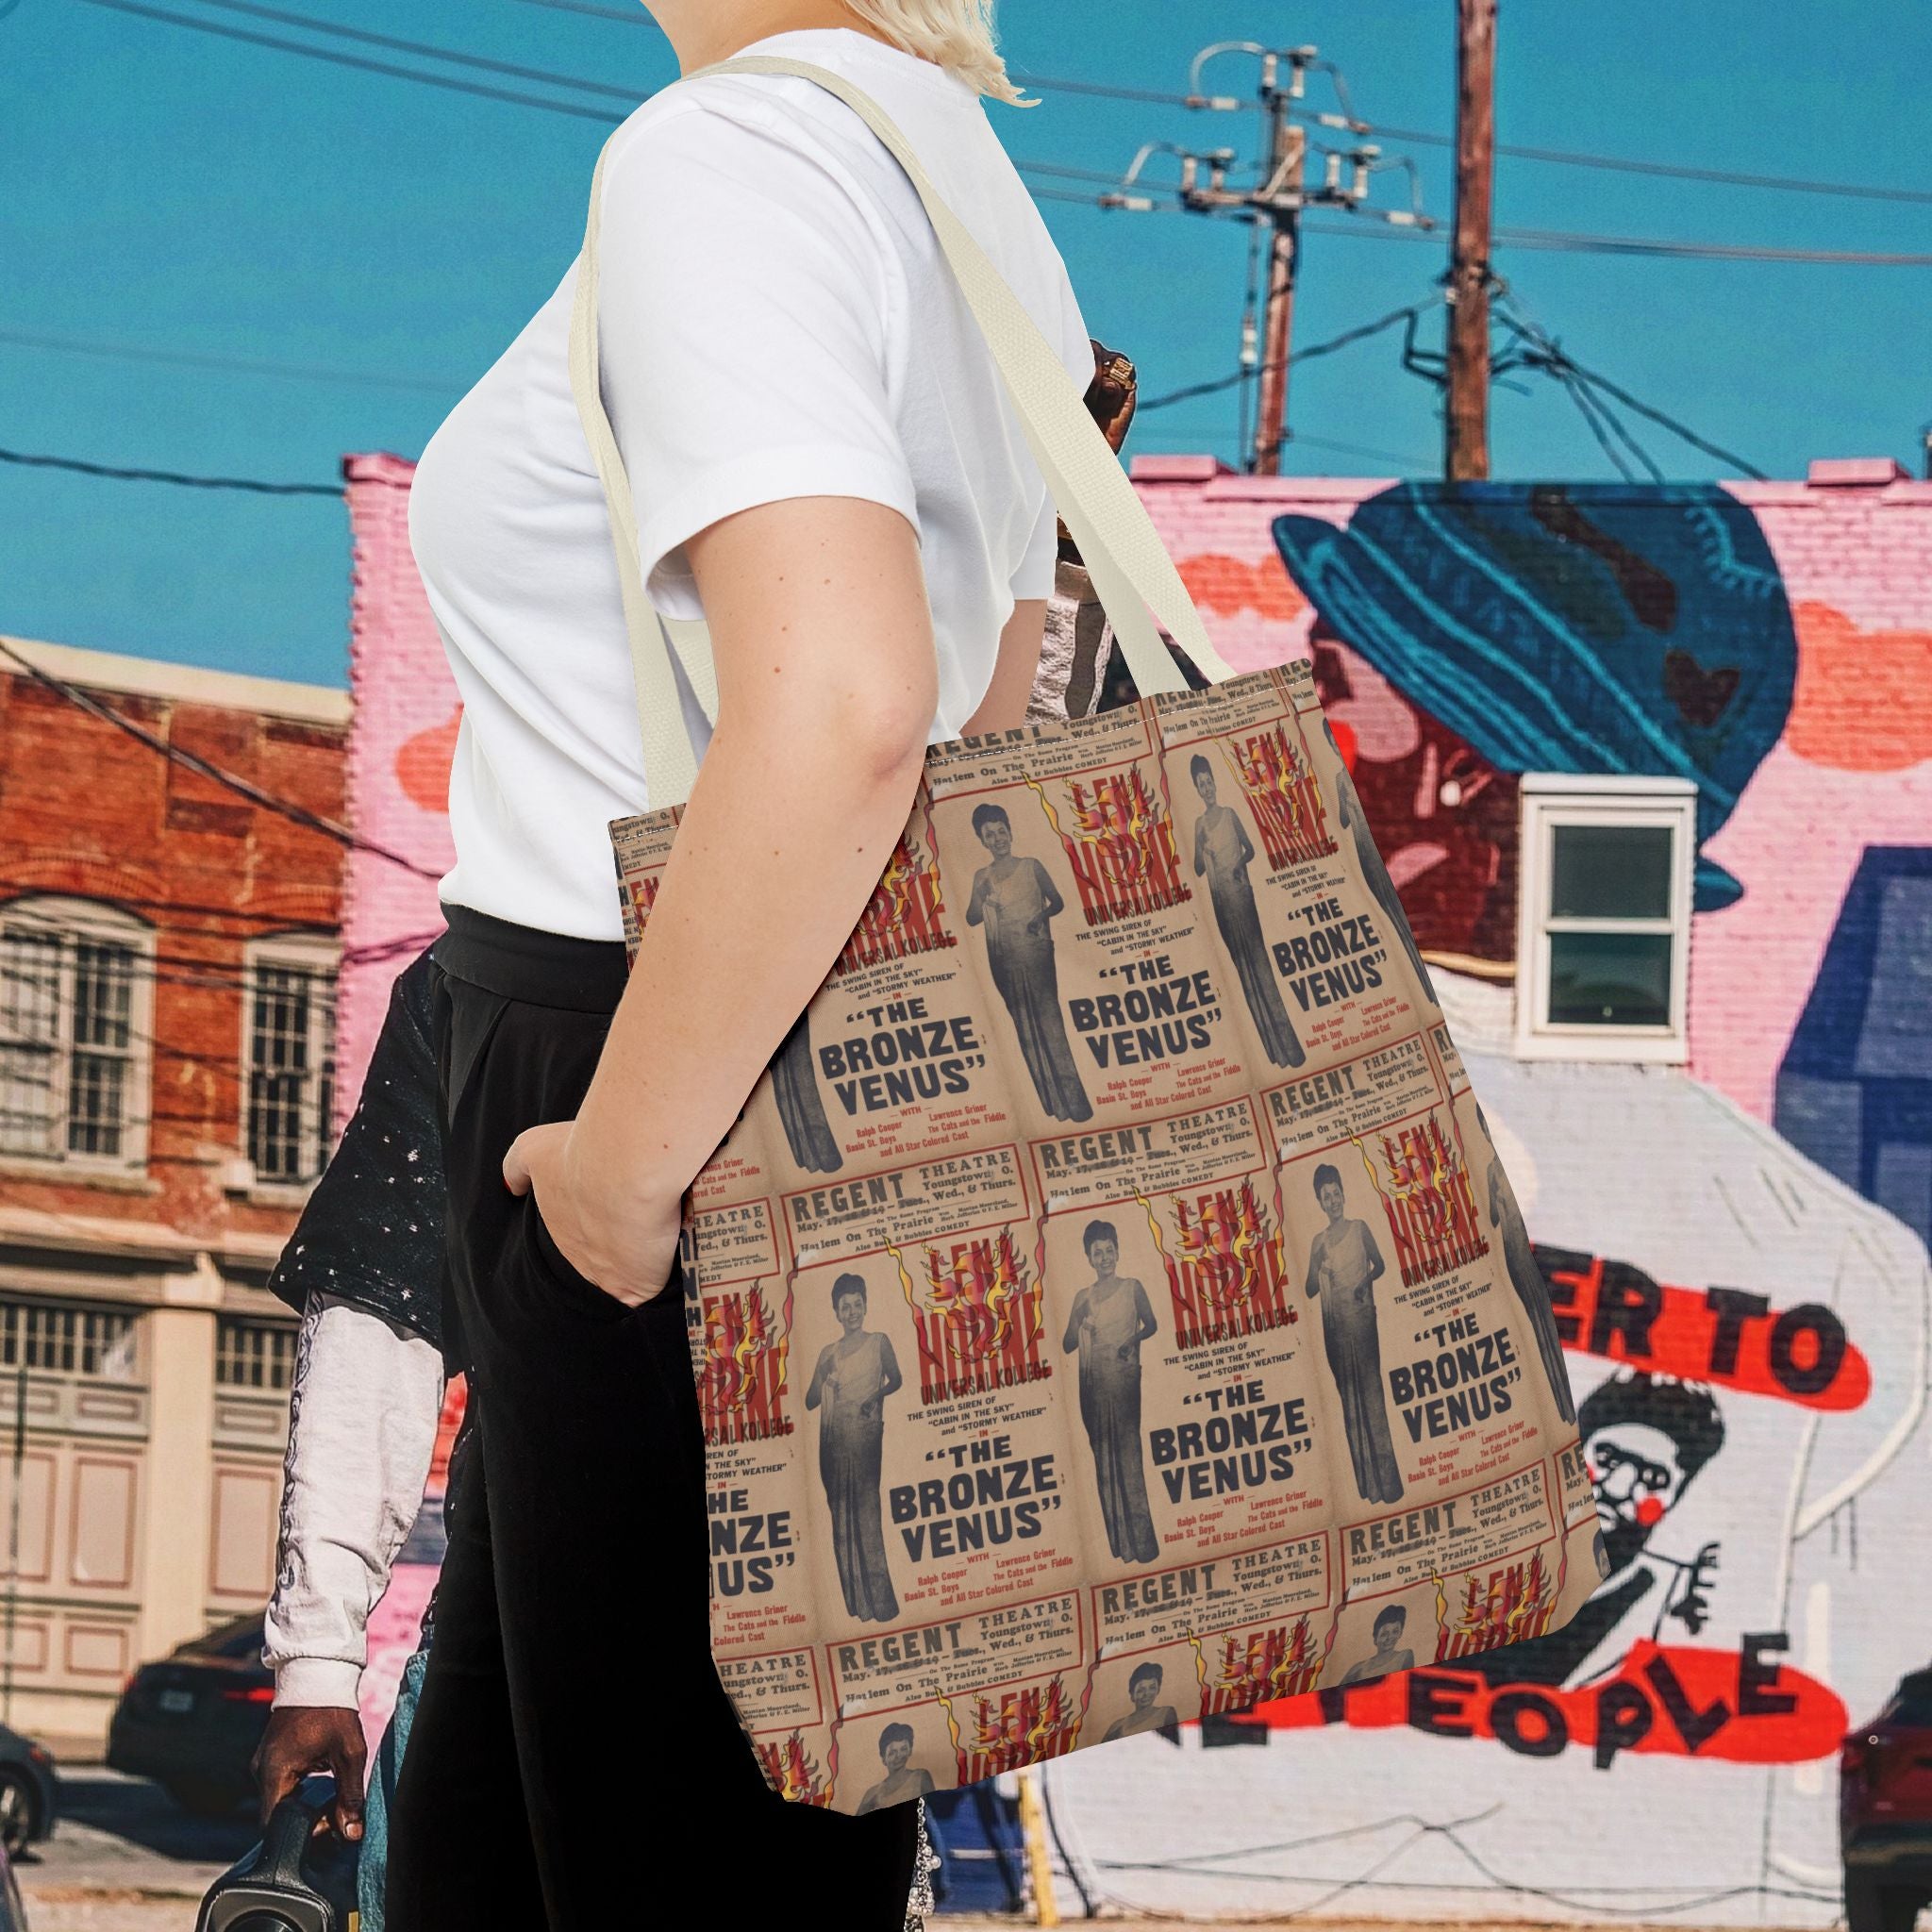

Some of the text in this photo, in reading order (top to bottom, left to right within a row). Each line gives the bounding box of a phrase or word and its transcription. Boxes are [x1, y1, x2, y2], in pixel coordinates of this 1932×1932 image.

[1076, 919, 1152, 941] THE SWING SIREN OF
[1272, 914, 1380, 977] BRONZE
[824, 962, 904, 991] THE SWING SIREN OF
[1070, 970, 1216, 1032] BRONZE
[819, 1016, 979, 1080] BRONZE
[1267, 1040, 1421, 1117] REGENT THEATRE
[1039, 1103, 1247, 1169] REGENT THEATRE
[791, 1151, 1010, 1223] REGENT THEATRE
[1163, 1341, 1248, 1366] THE SWING SIREN OF
[1389, 1327, 1516, 1406] BRONZE
[1707, 1286, 1846, 1395] TO
[907, 1395, 996, 1422] THE SWING SIREN OF
[1149, 1398, 1308, 1466] BRONZE
[890, 1454, 1058, 1524] BRONZE
[1177, 1510, 1224, 1527] Ralph Cooper
[1223, 1494, 1244, 1506] WITH
[1250, 1491, 1307, 1510] Lawrence Griner
[1349, 1469, 1541, 1556] REGENT THEATRE
[1164, 1531, 1184, 1543] Basin
[1198, 1524, 1216, 1535] Boys
[1101, 1563, 1216, 1615] REGENT
[1231, 1539, 1321, 1571] THEATRE
[836, 1597, 1072, 1673] REGENT THEATRE
